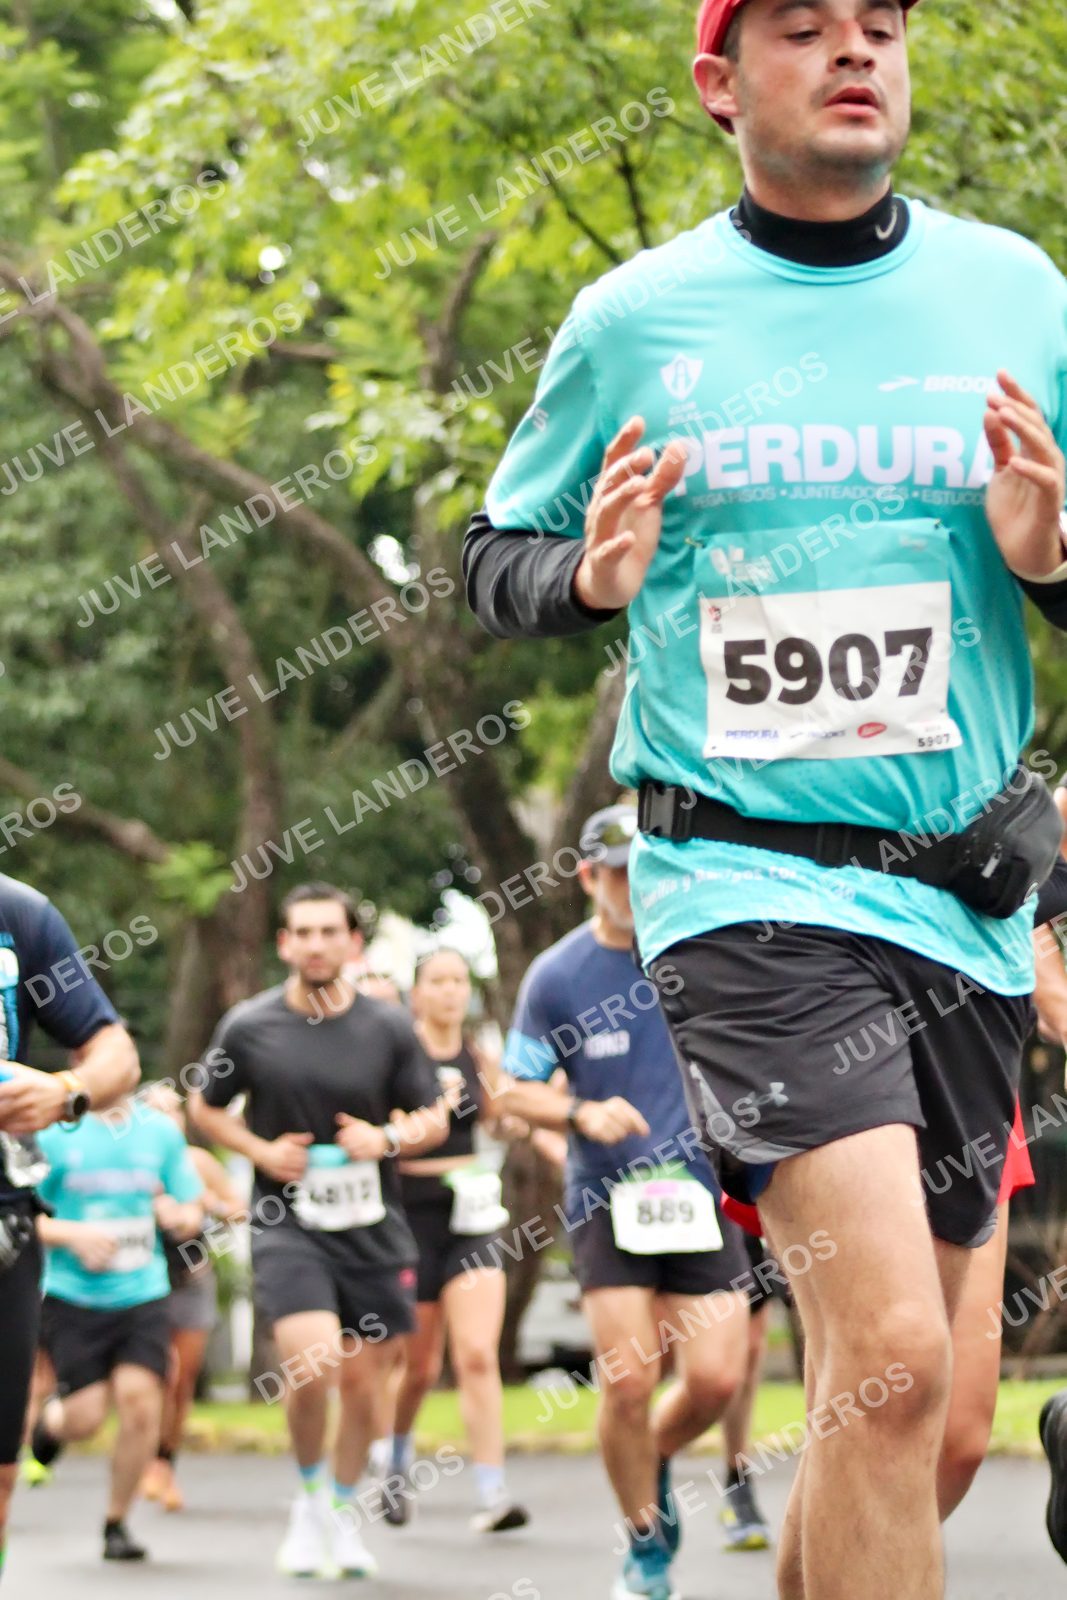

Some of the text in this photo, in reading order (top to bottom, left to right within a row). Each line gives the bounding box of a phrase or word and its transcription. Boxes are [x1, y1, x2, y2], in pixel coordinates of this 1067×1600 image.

[924, 375, 997, 392] BROO
[723, 626, 933, 705] 5907
[917, 733, 950, 748] 5907
